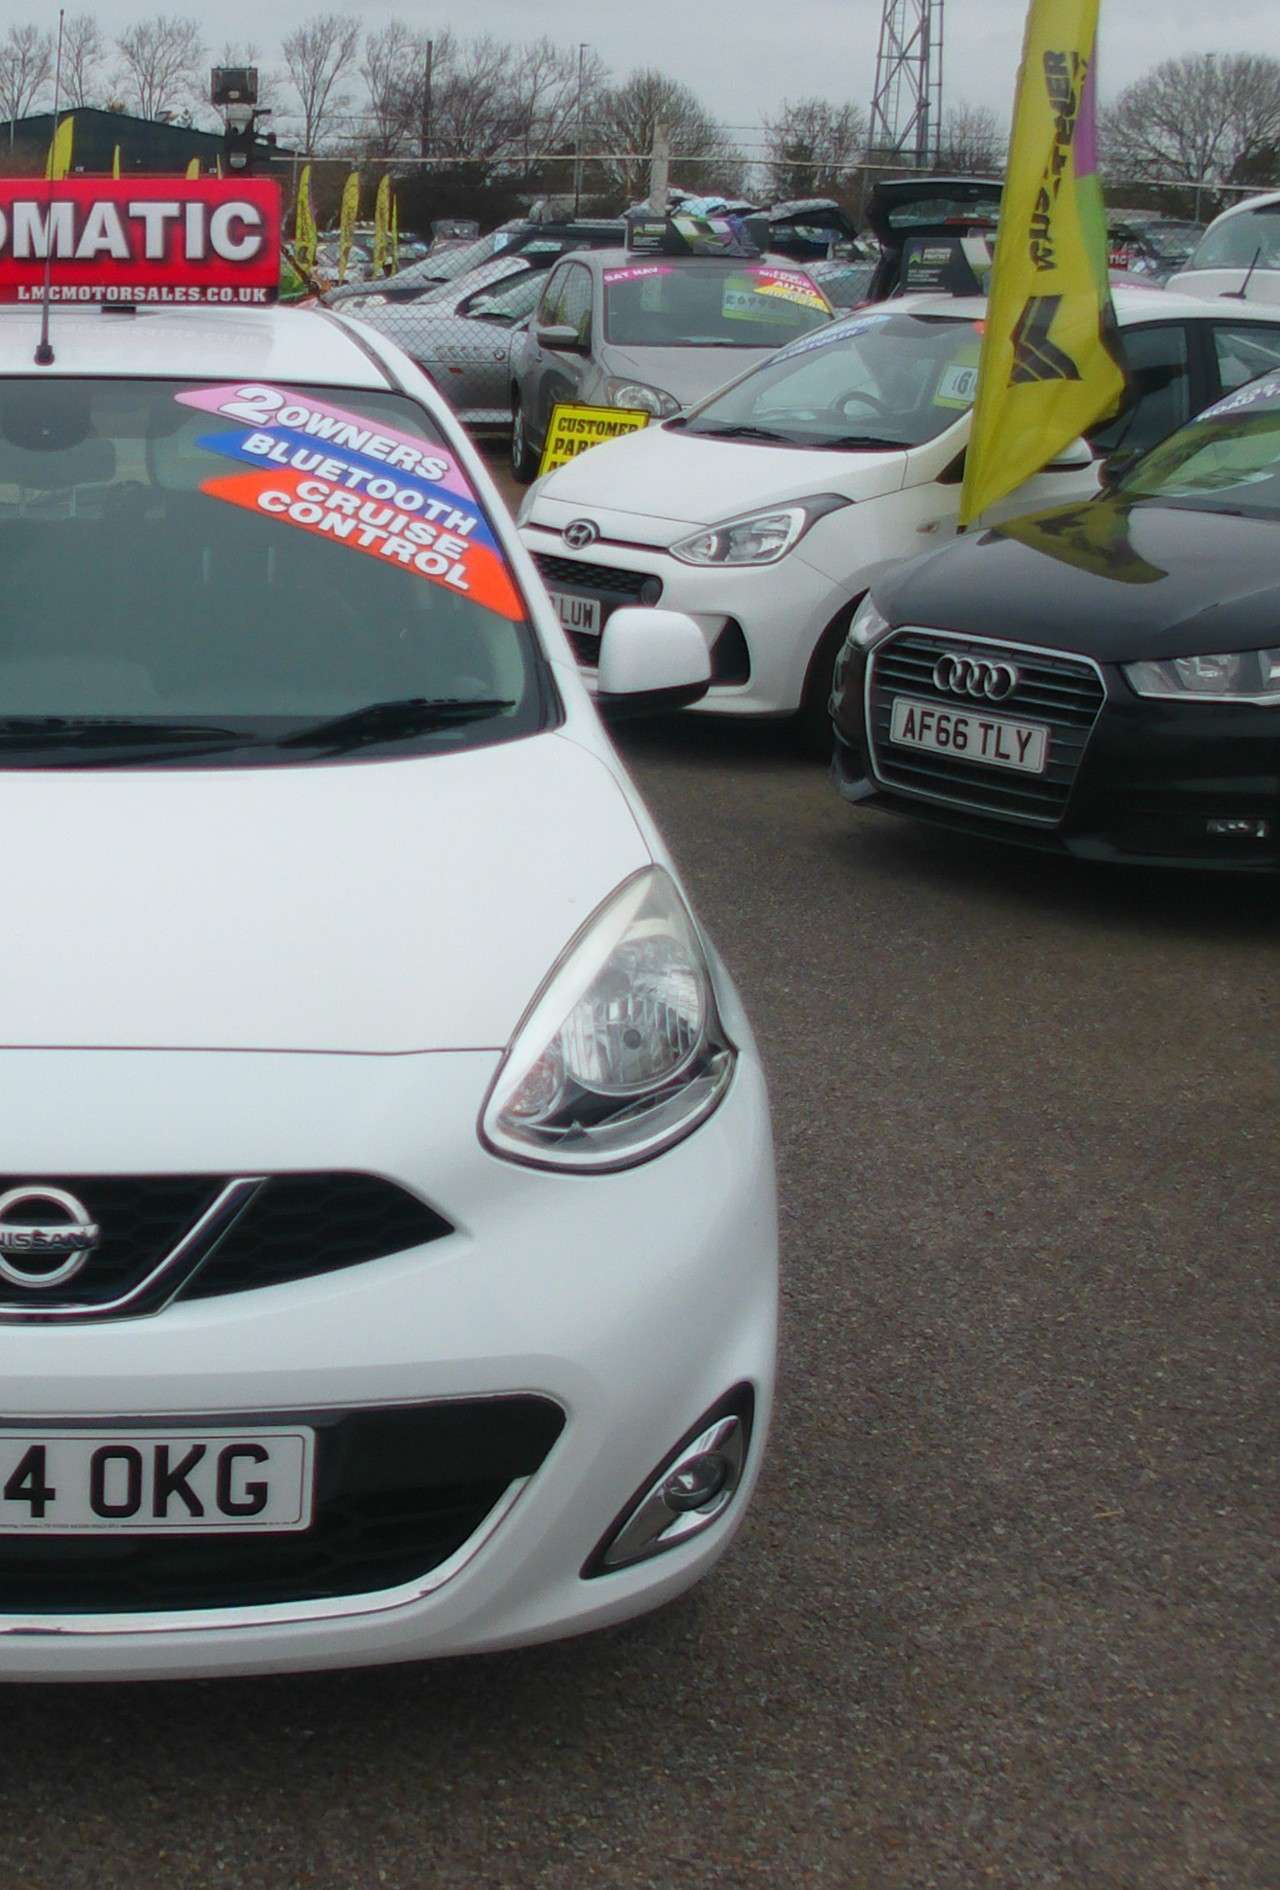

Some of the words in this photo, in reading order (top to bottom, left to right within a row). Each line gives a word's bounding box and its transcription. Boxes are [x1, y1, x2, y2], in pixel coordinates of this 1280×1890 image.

[17, 285, 267, 302] LMCMOTORSALES.CO.UK
[218, 387, 285, 425] 2
[276, 406, 449, 482] OWNERS
[240, 432, 478, 536] BLUETOOTH
[295, 480, 469, 560] CRUISE
[257, 490, 470, 590] CONTROL
[902, 707, 969, 751] AF66
[978, 721, 1033, 763] TLY
[89, 1443, 270, 1519] OKG
